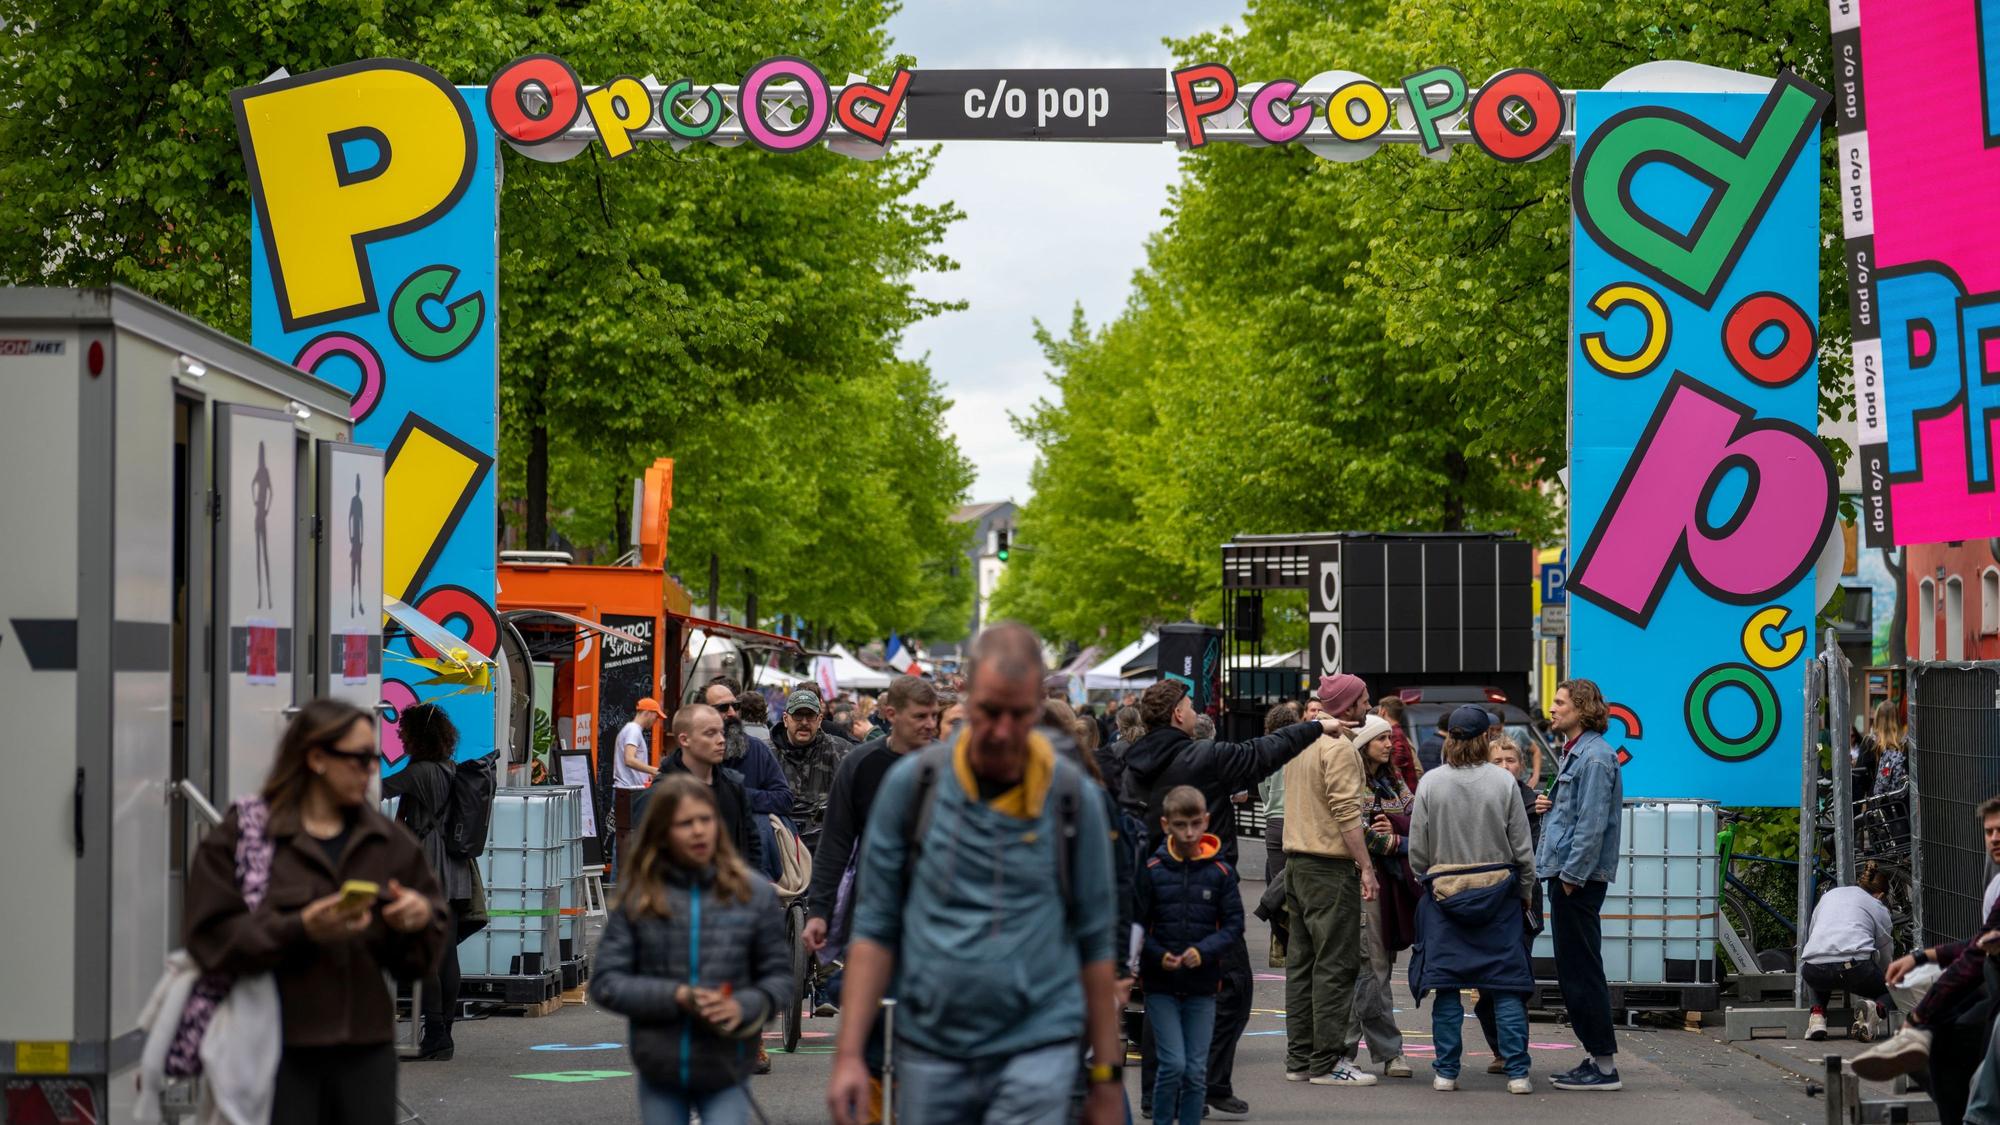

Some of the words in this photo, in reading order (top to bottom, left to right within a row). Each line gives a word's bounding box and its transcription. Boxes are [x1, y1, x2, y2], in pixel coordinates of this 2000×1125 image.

[1843, 45, 1857, 78] c/o
[964, 79, 1026, 117] c/o
[1038, 88, 1109, 126] pop
[1844, 82, 1857, 119] pop
[1850, 148, 1863, 181] c/o
[1850, 186, 1864, 222] pop
[1857, 251, 1869, 284] c/o
[1858, 289, 1871, 325] pop
[1864, 355, 1877, 386] c/o
[1865, 393, 1878, 429] pop
[1870, 459, 1884, 492] c/o
[1871, 496, 1884, 533] pop
[1548, 569, 1564, 599] P
